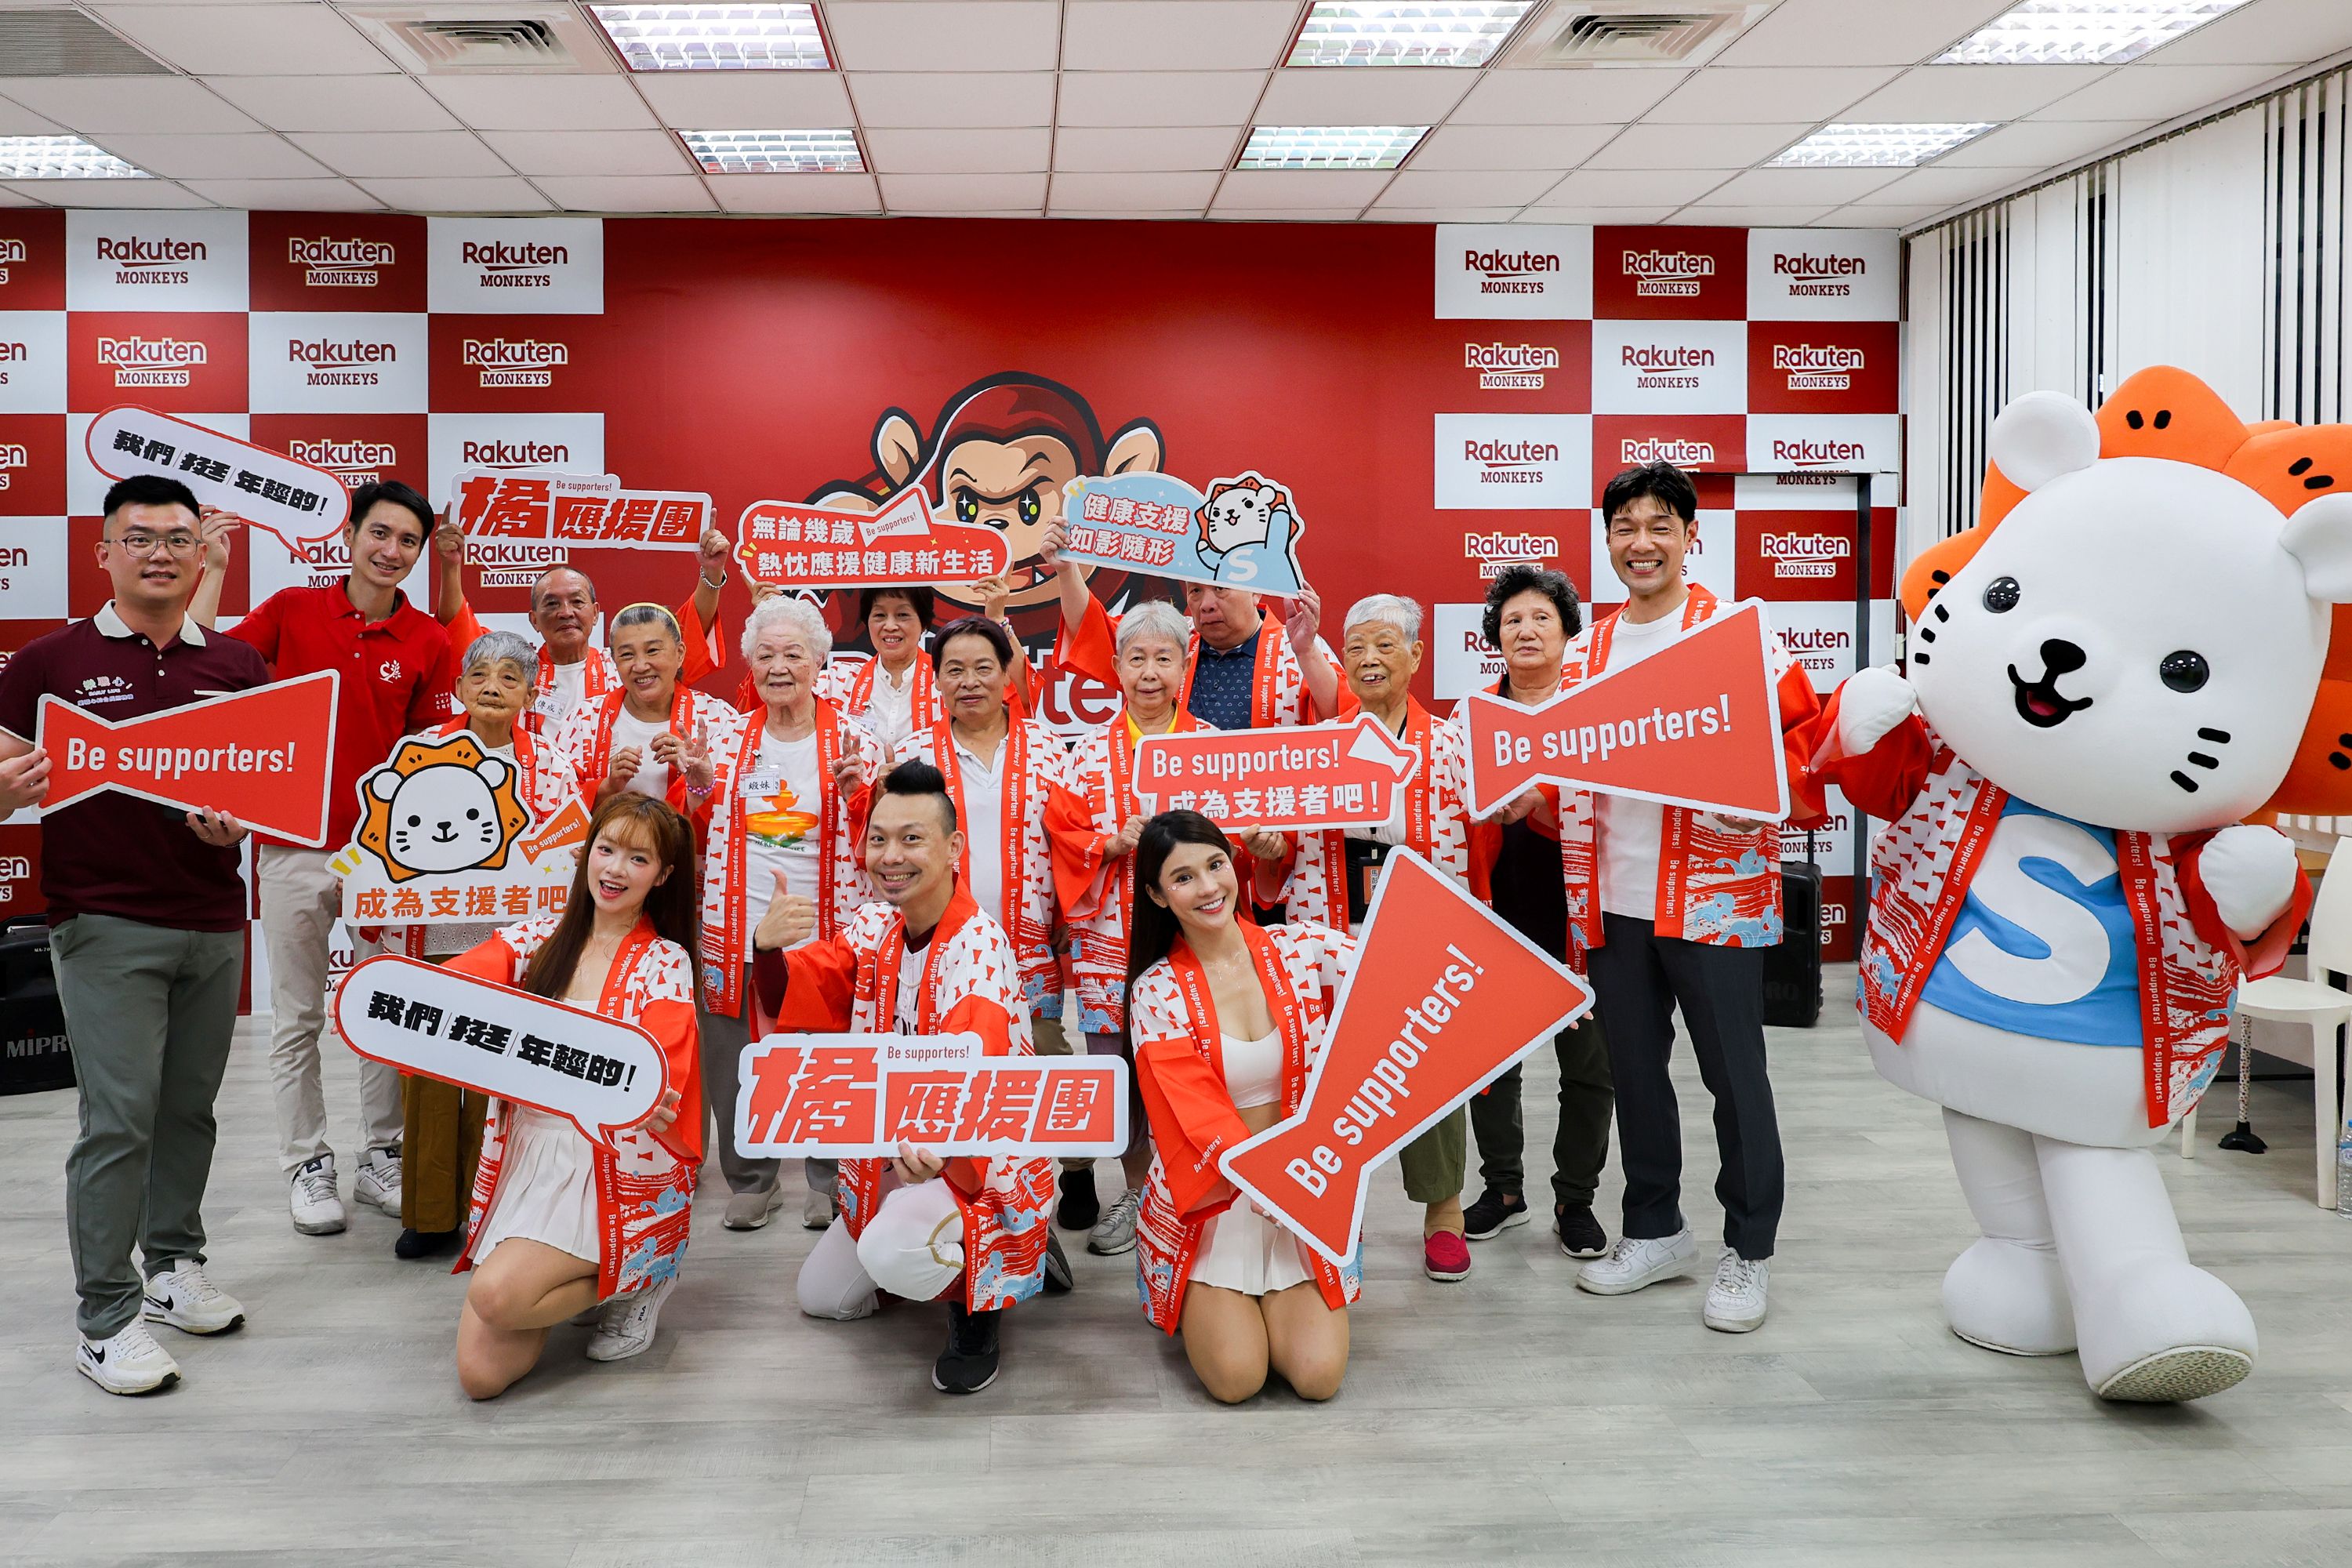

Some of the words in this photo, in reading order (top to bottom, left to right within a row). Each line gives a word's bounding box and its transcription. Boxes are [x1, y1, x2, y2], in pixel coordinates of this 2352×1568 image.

[97, 236, 206, 260] Rakuten
[291, 238, 393, 263] Rakuten
[463, 241, 568, 264] Rakuten
[1465, 249, 1559, 272] Rakuten
[1625, 252, 1712, 274] Rakuten
[1774, 253, 1865, 275] Rakuten
[116, 271, 188, 284] MONKEYS
[308, 272, 376, 285] MONKEYS
[480, 274, 550, 287] MONKEYS
[1481, 282, 1544, 294] MONKEYS
[1639, 283, 1698, 294] MONKEYS
[1789, 285, 1850, 296] MONKEYS
[100, 338, 205, 362] Rakuten
[289, 339, 396, 361] Rakuten
[465, 340, 565, 362] Rakuten
[1467, 345, 1557, 367] Rakuten
[1622, 345, 1714, 366] Rakuten
[1776, 347, 1863, 368] Rakuten
[118, 372, 187, 384] MONKEYS
[307, 372, 379, 386] MONKEYS
[482, 372, 550, 385] MONKEYS
[1482, 376, 1542, 387] MONKEYS
[1637, 376, 1699, 389] MONKEYS
[1790, 377, 1849, 388] MONKEYS
[292, 441, 394, 464] Rakuten
[463, 441, 568, 463] Rakuten
[1465, 439, 1559, 461] Rakuten
[1624, 440, 1712, 463] Rakuten
[1773, 439, 1864, 460] Rakuten
[556, 480, 566, 490] Be
[568, 481, 612, 492] supporters!
[1480, 471, 1543, 483] MONKEYS
[866, 527, 877, 536] Be
[877, 512, 917, 533] supporters!
[1083, 492, 1190, 535] 健康支援
[752, 514, 855, 545] 無論幾歲
[466, 543, 565, 563] Rakuten
[1069, 524, 1176, 567] 如影隨形
[1467, 534, 1556, 555] Rakuten
[1762, 534, 1849, 556] Rakuten
[758, 549, 993, 577] 熱忱應援健康新生活
[1777, 564, 1835, 576] MONKEYS
[1116, 729, 1124, 739] Be
[1494, 729, 1532, 767] Be
[1542, 693, 1733, 764] supporters!
[67, 738, 106, 771] Be
[117, 741, 296, 780] supporters!
[1152, 749, 1182, 778] Be
[1192, 739, 1340, 782] supporters!
[1414, 789, 1423, 798] Be
[527, 845, 539, 854] Be
[539, 818, 581, 848] supporters!
[1010, 827, 1018, 837] Be
[1671, 806, 1683, 849] upporters!
[1973, 825, 1984, 837] Be
[734, 837, 739, 848] Be
[1330, 841, 1338, 851] Be
[1669, 859, 1680, 869] Be
[1953, 837, 1978, 886] supporters!
[1010, 888, 1018, 898] Be
[2134, 878, 2147, 890] Be
[731, 895, 739, 905] Be
[1666, 872, 1677, 918] supporters!
[1945, 894, 1956, 907] Be
[1944, 813, 2121, 1006] S
[2136, 891, 2156, 945] supporters!
[1924, 907, 1949, 955] supporters!
[630, 943, 641, 952] Be
[731, 953, 738, 962] Be
[938, 942, 949, 953] Be
[1261, 946, 1269, 957] Be
[1265, 958, 1287, 998] supporters!
[1914, 961, 1925, 974] Be
[2147, 956, 2158, 968] Be
[881, 975, 890, 985] Be
[929, 953, 942, 1002] supporters!
[1185, 971, 1194, 982] Be
[608, 996, 619, 1007] Be
[1189, 983, 1210, 1028] supporters!
[1309, 1003, 1320, 1014] Be
[1896, 974, 1918, 1022] supporters!
[2148, 971, 2164, 1025] supporters!
[929, 1012, 937, 1023] Be
[1201, 1038, 1211, 1050] Be
[1283, 1004, 1293, 1016] Be
[1288, 1018, 1300, 1067] supporters!
[2154, 1036, 2165, 1049] Be
[887, 1046, 902, 1059] Be
[905, 1045, 971, 1062] supporters!
[1284, 1145, 1343, 1199] Be
[1333, 942, 1486, 1146] supporters!
[2152, 1051, 2165, 1104] supporters!
[1291, 1076, 1299, 1087] Be
[603, 1153, 615, 1204] supporters!
[608, 1214, 617, 1225] Be
[608, 1227, 618, 1278] supporters!
